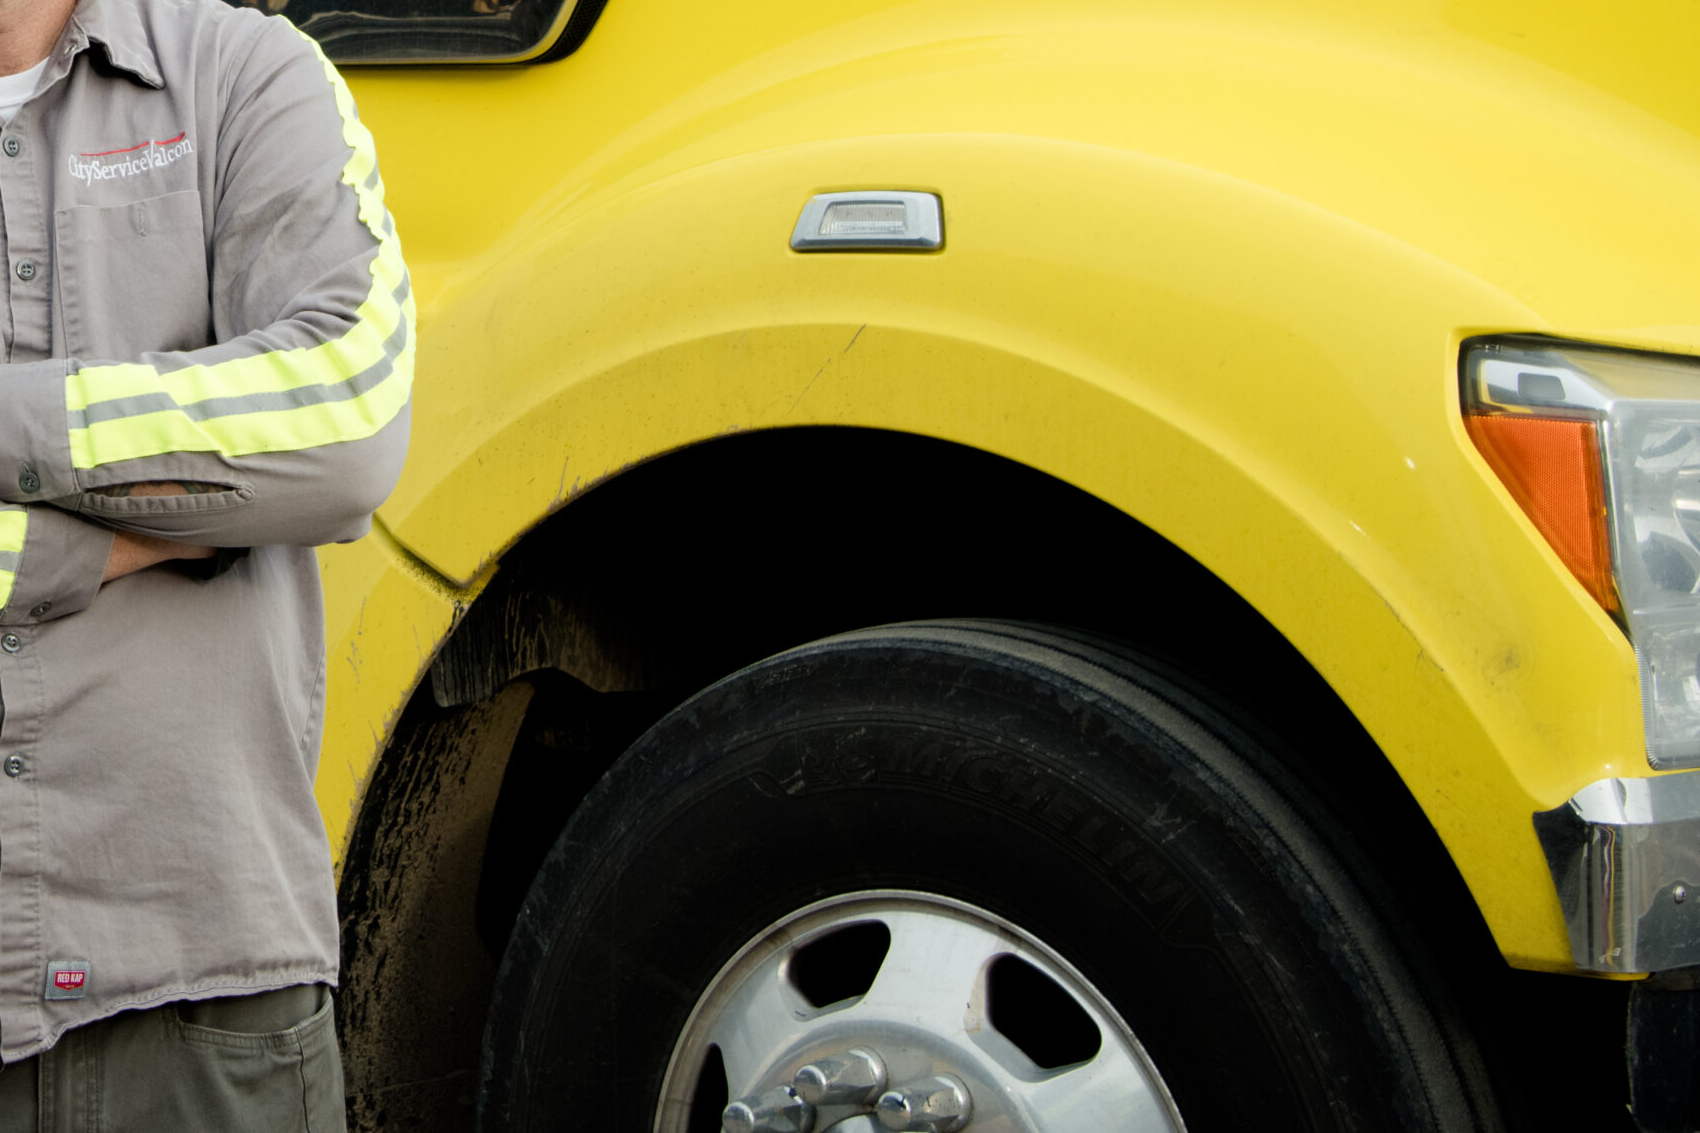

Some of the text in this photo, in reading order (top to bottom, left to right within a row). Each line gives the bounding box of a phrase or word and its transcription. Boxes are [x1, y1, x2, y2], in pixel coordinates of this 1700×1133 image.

[68, 138, 194, 187] CityServiceValcon
[882, 736, 1189, 906] MICHELIN
[57, 973, 84, 983] RED KAP
